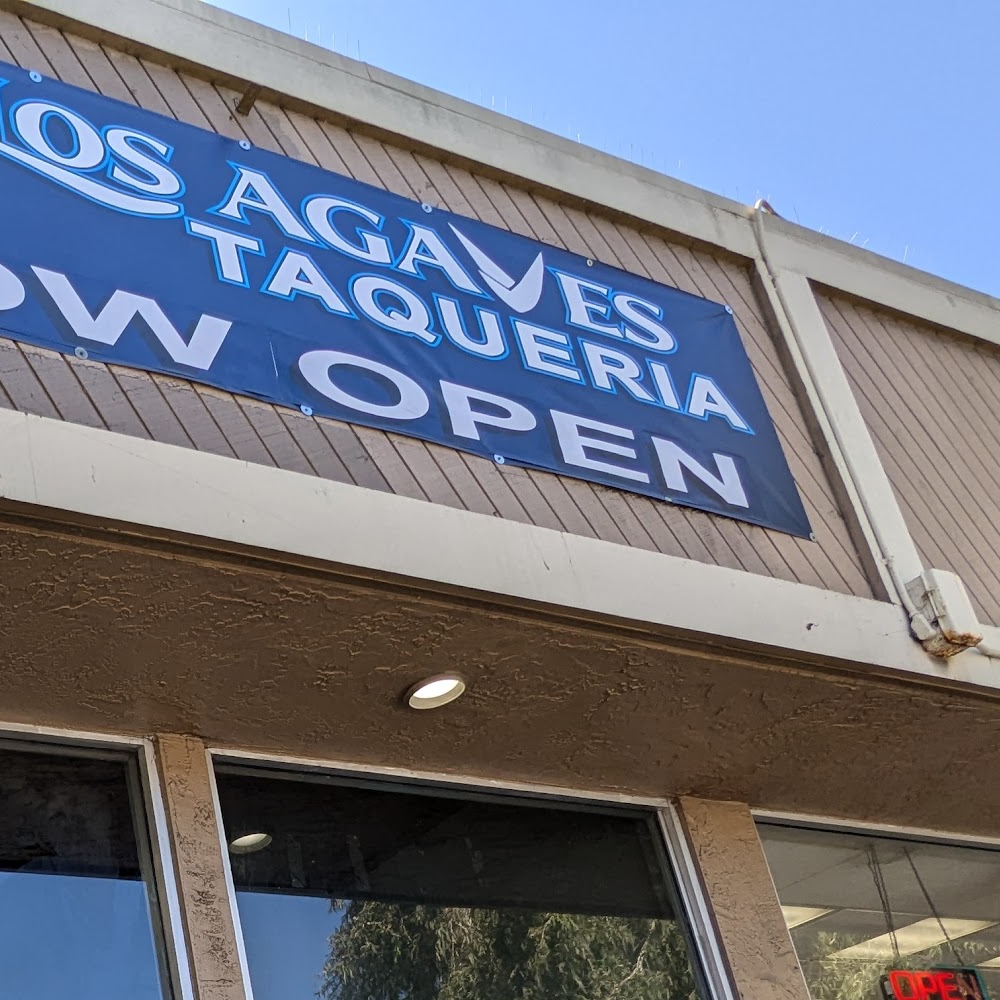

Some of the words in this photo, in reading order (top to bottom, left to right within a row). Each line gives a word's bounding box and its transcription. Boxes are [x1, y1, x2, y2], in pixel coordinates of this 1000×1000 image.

[185, 216, 755, 434] TAQUERIA
[211, 160, 677, 355] AGAVES
[298, 349, 750, 508] OPEN
